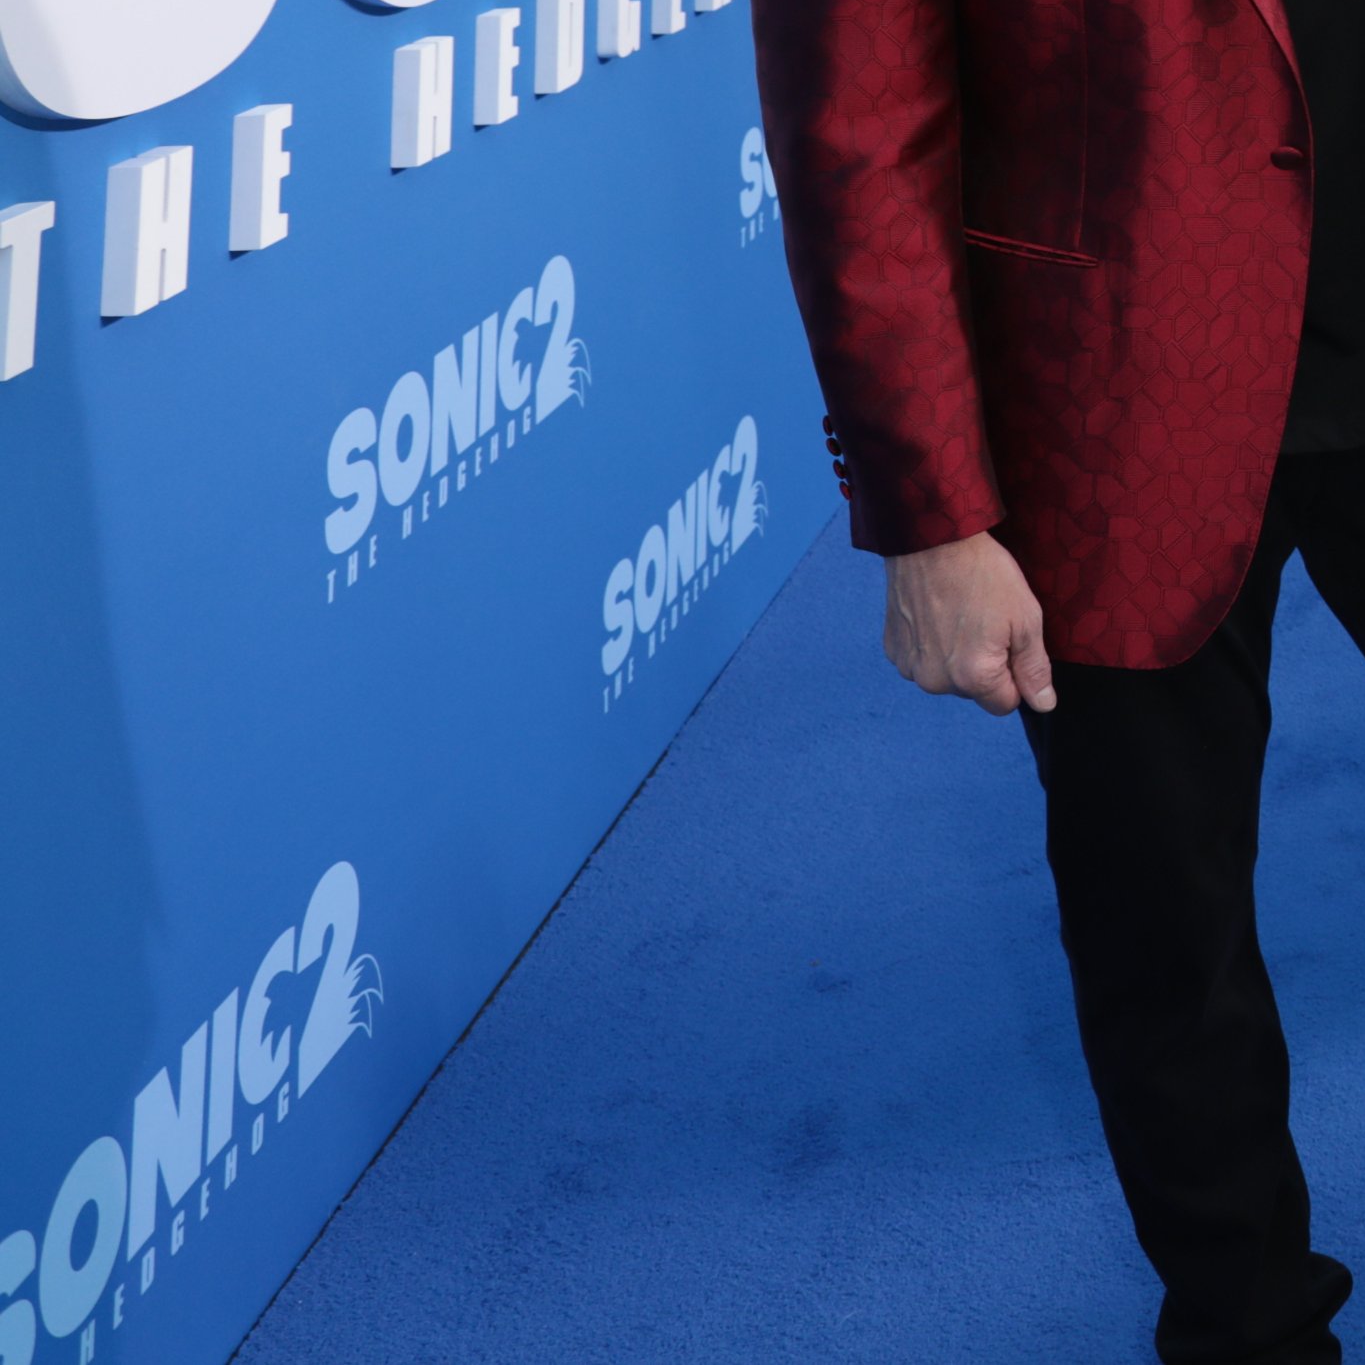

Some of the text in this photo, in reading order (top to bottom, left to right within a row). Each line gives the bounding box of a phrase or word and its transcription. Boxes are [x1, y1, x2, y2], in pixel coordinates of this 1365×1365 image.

[326, 406, 532, 605] THE HEDGEHOG
[603, 540, 731, 715] THE HEDGEHOG
[80, 1081, 291, 1365] HEDGEHOG
